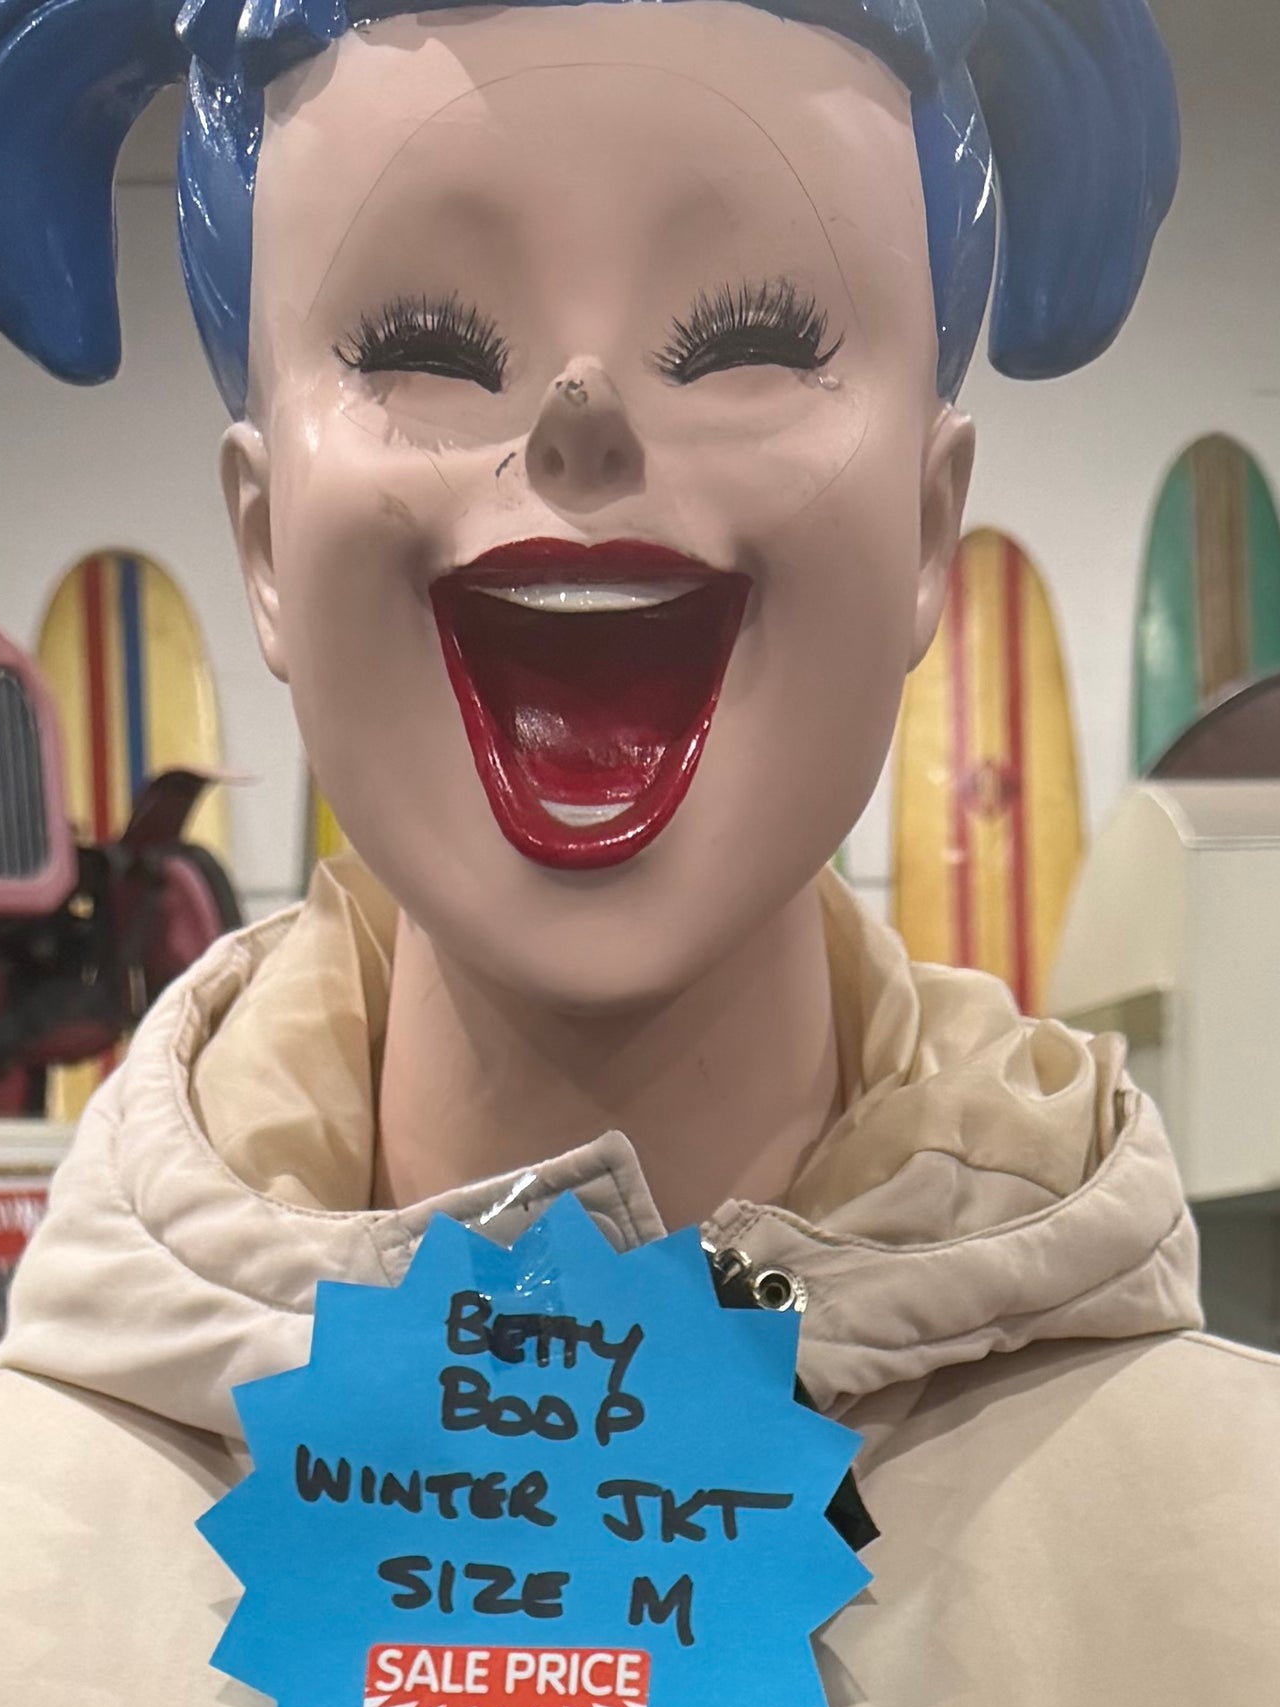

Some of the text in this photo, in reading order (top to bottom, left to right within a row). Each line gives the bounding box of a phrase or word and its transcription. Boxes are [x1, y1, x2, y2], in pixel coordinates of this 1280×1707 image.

[295, 1443, 794, 1543] WINTER JKT
[378, 1555, 695, 1646] SIZE M
[375, 1649, 642, 1697] SALE PRICE
